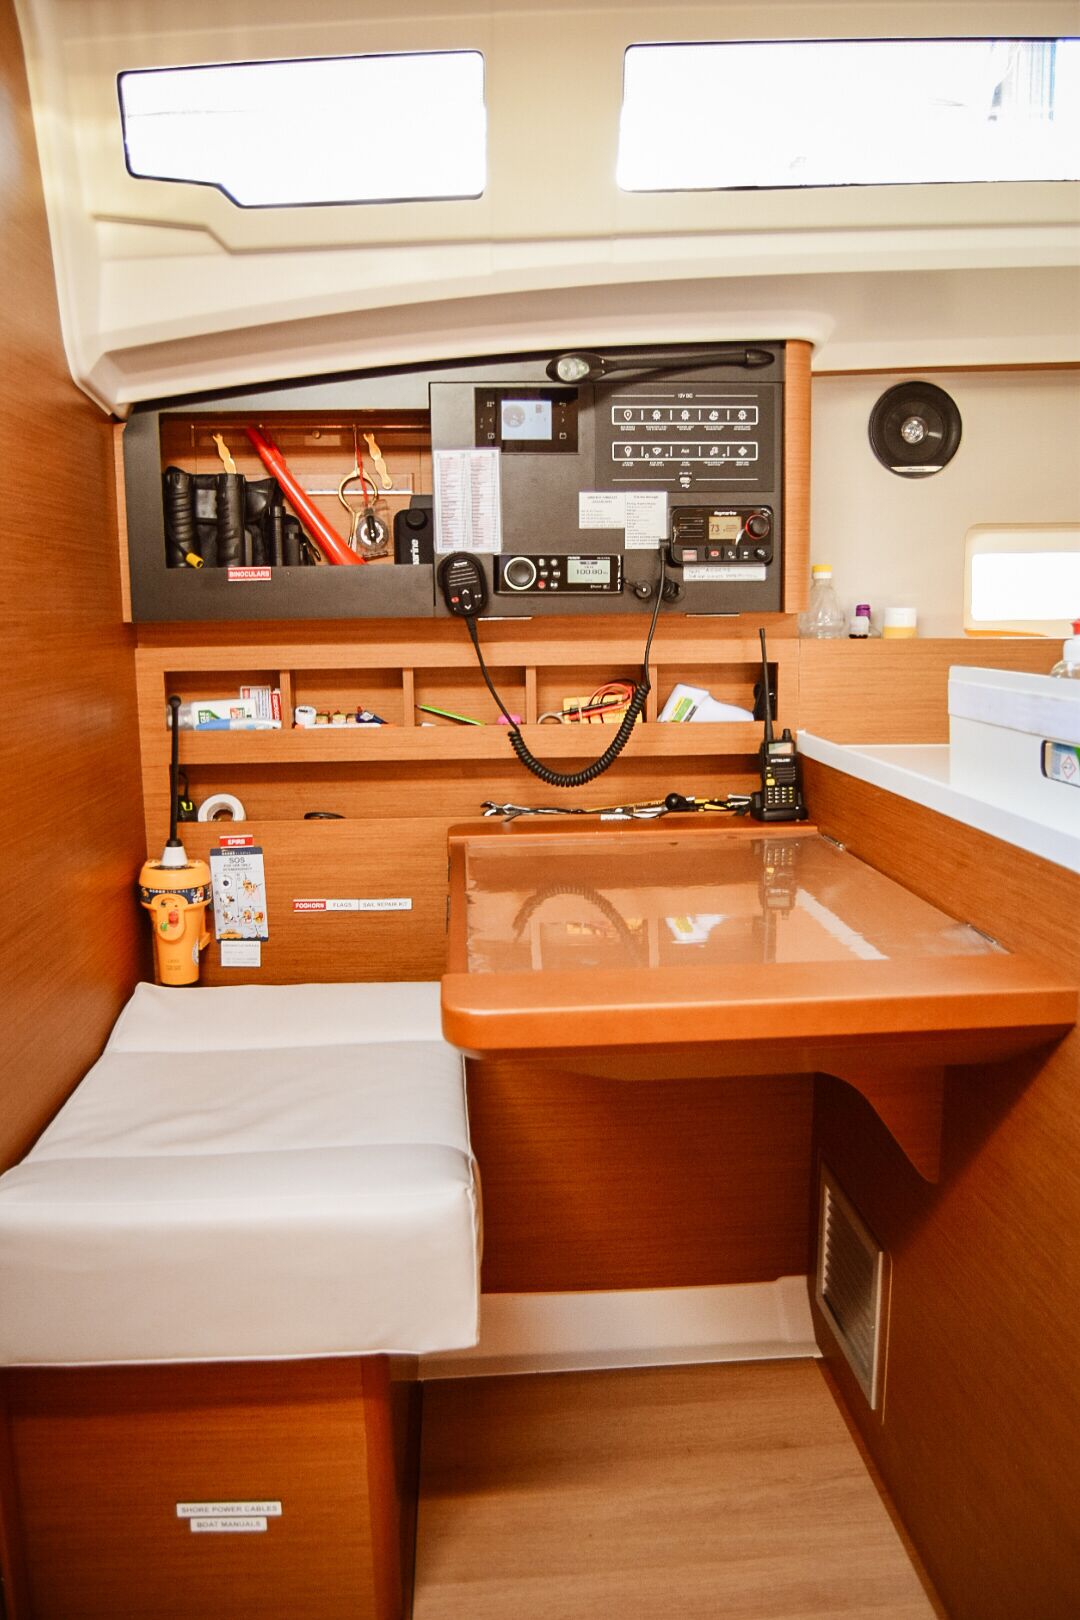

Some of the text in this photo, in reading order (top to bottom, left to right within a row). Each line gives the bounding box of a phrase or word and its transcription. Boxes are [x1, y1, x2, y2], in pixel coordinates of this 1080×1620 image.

[229, 569, 270, 578] BINOCULARS
[244, 1504, 278, 1512] CABLES
[221, 1520, 261, 1528] MANUALS
